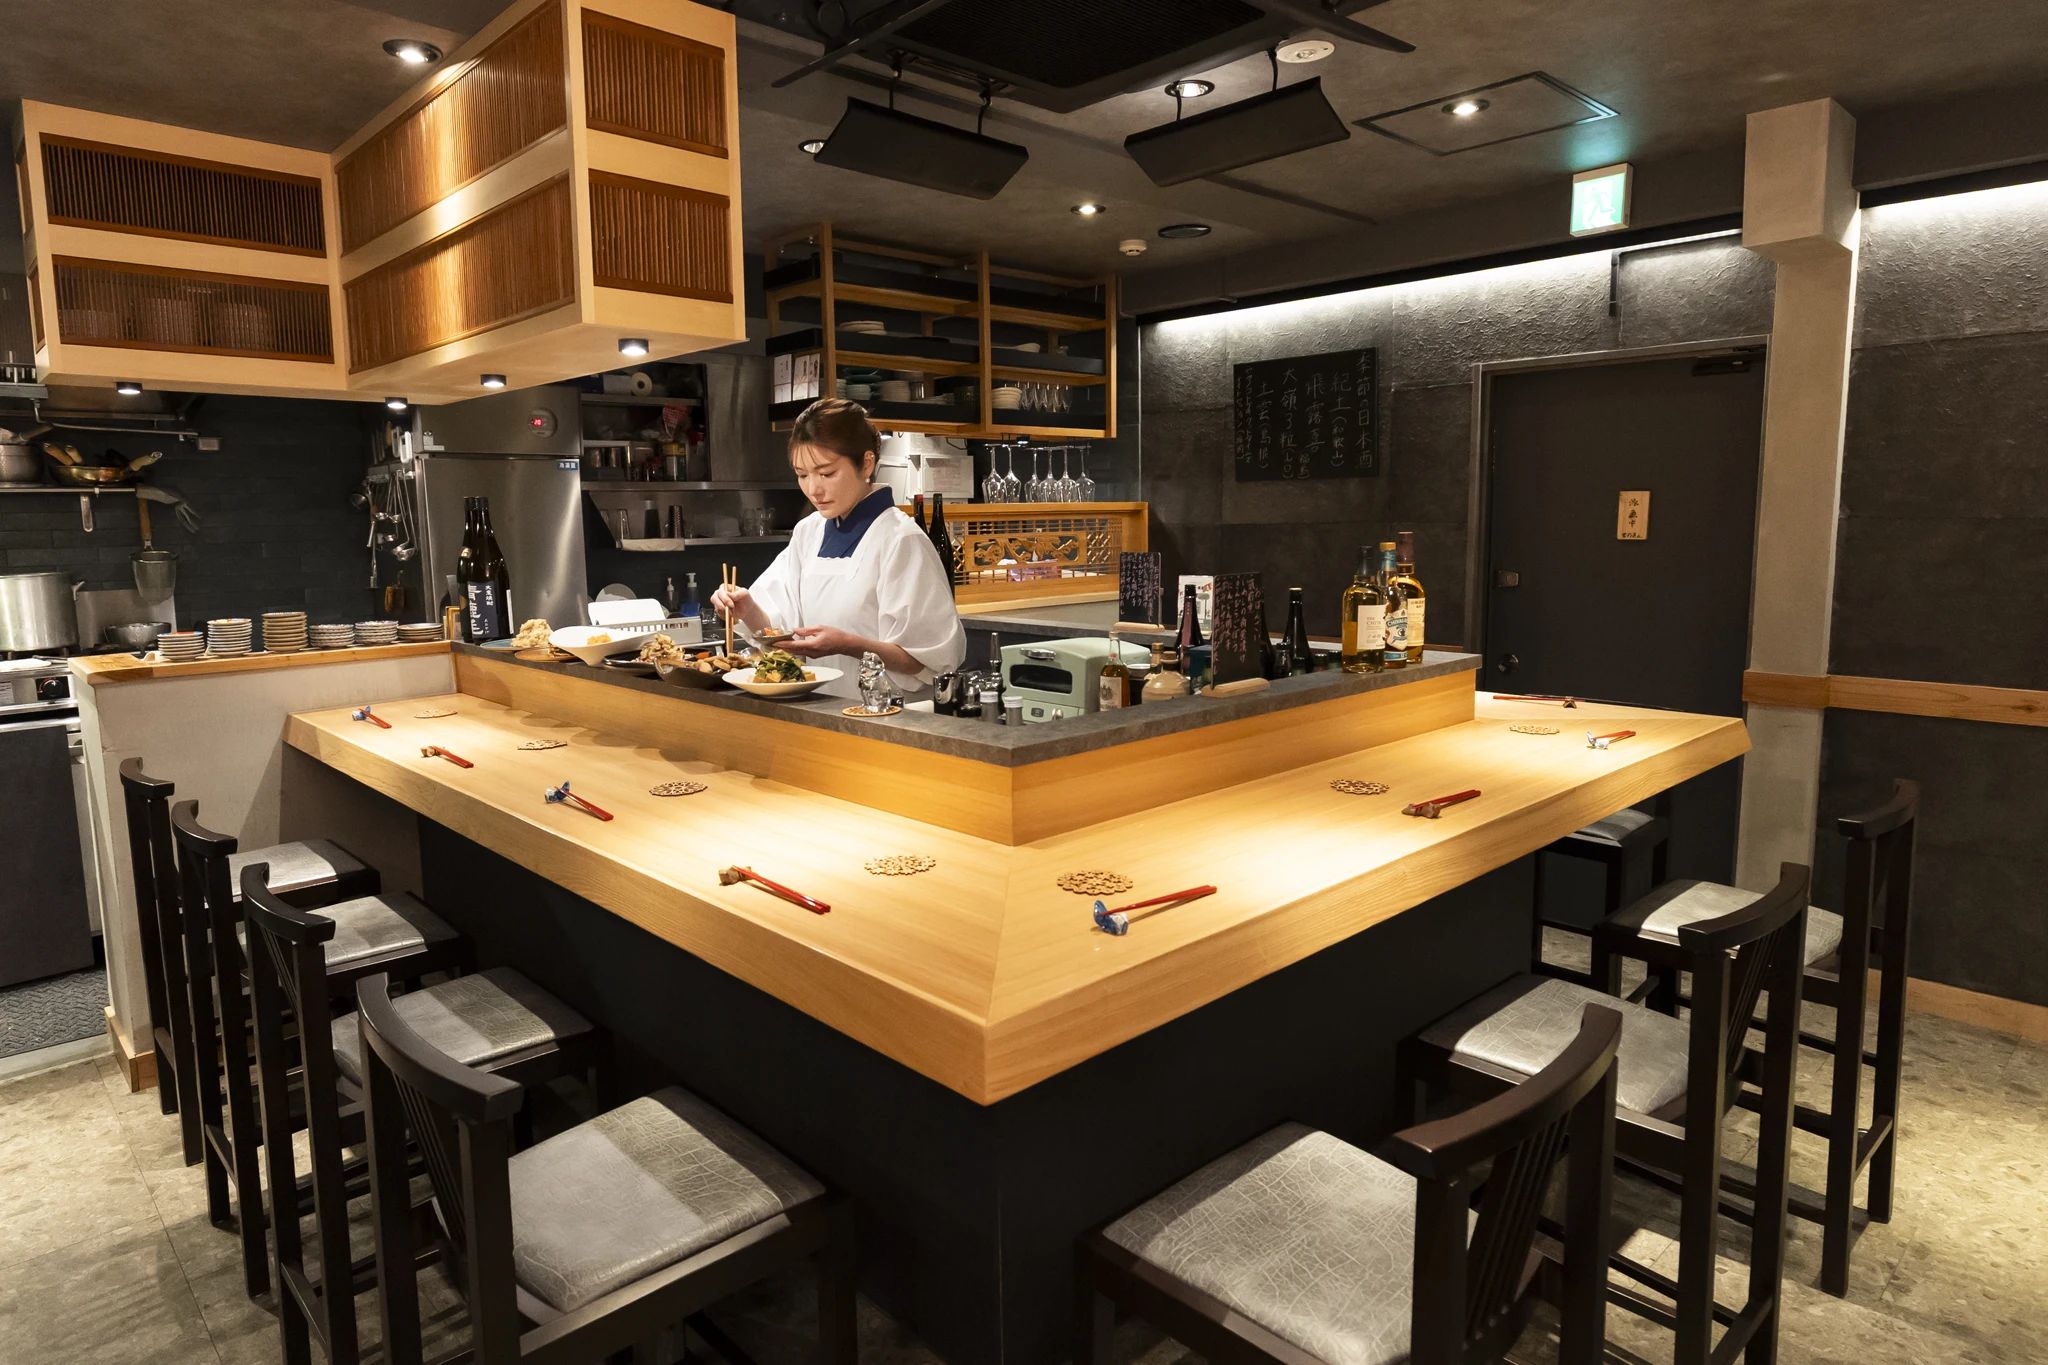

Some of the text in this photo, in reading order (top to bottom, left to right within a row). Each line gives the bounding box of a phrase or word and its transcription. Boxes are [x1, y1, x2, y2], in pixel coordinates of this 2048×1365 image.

[1355, 352, 1373, 469] 季節の日本酒
